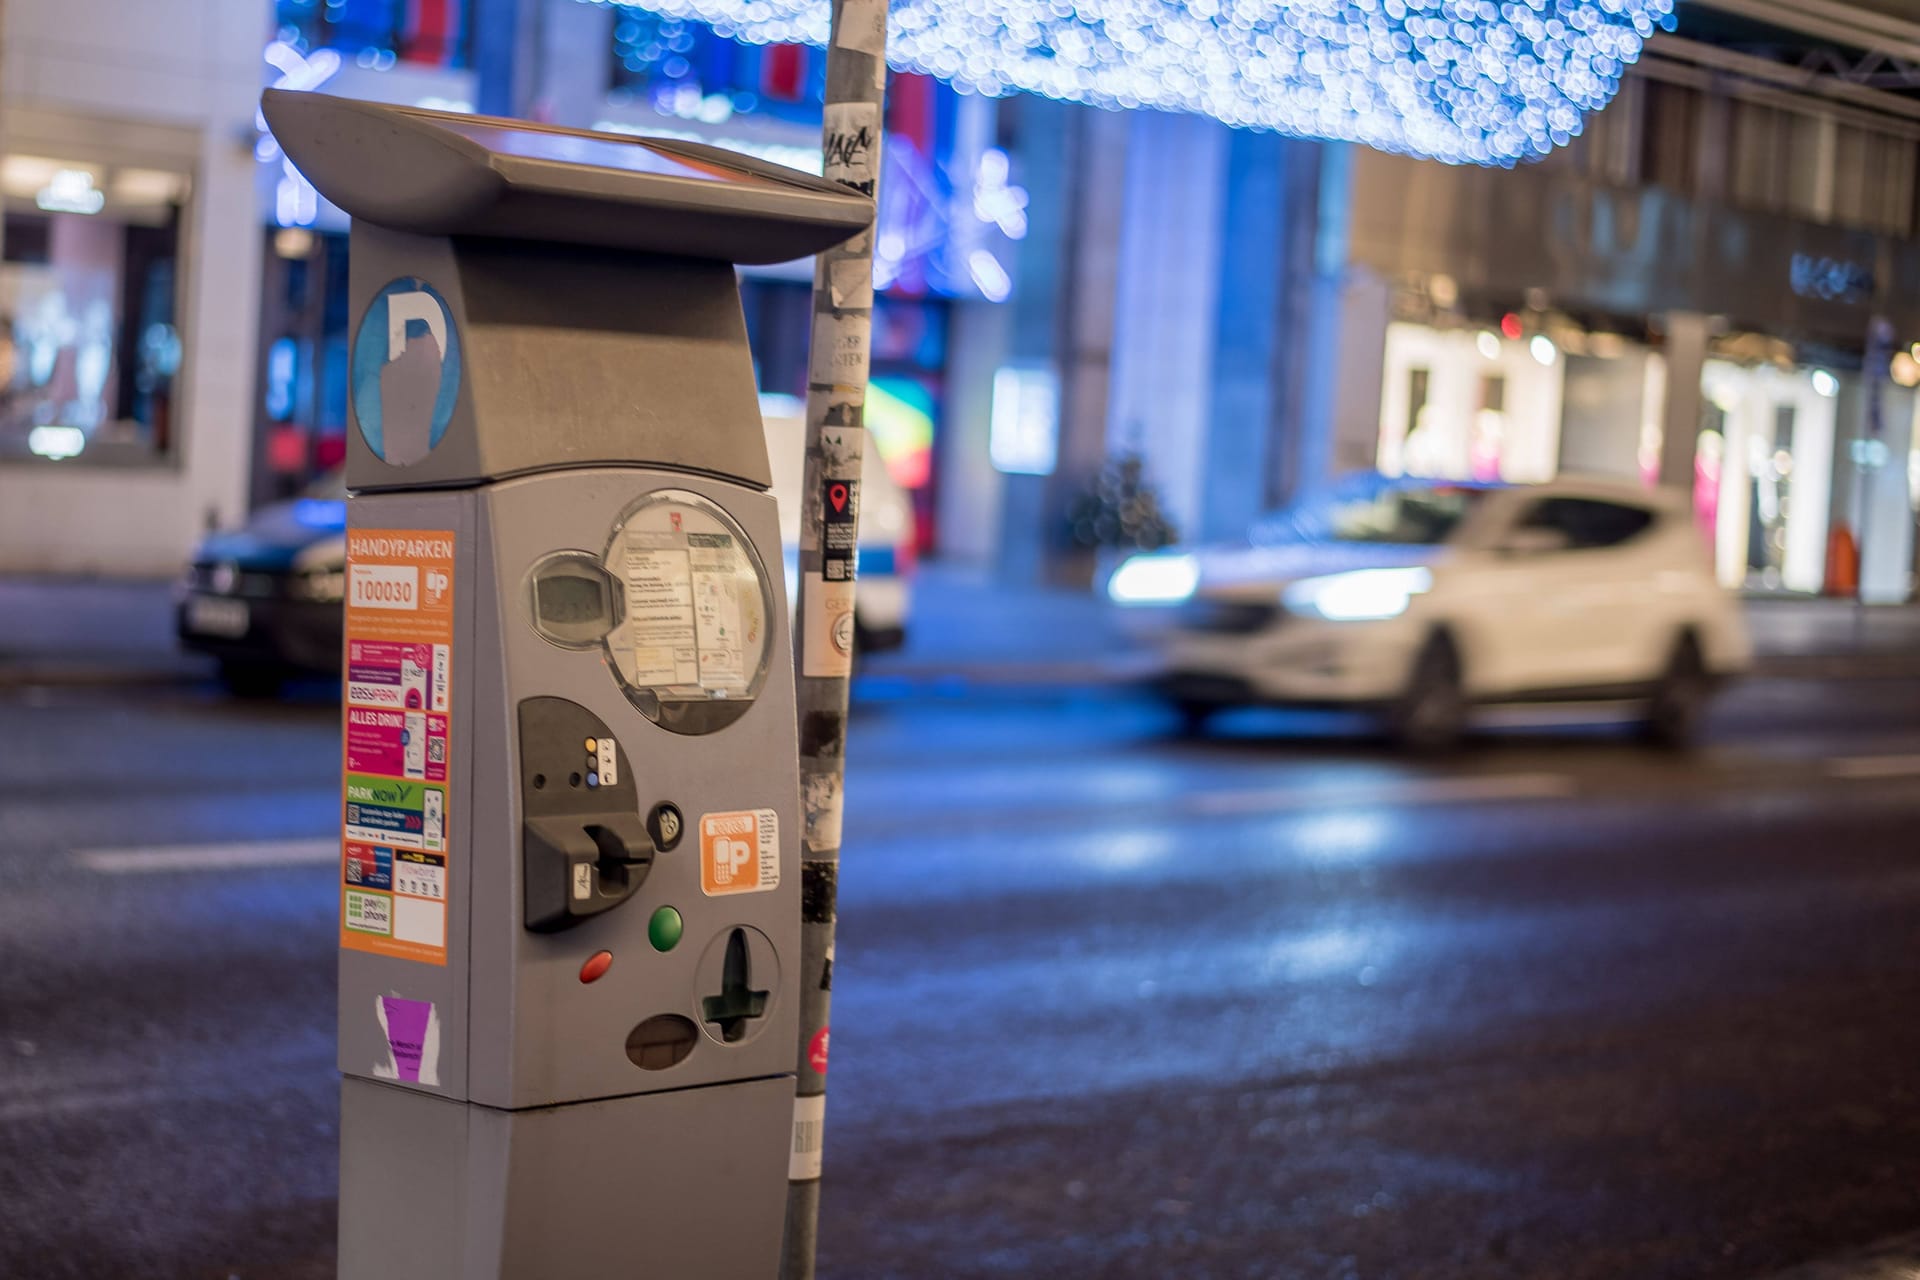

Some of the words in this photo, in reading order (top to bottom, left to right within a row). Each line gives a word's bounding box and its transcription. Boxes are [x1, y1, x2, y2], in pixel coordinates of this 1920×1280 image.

[351, 538, 452, 559] HANDYPARKEN
[357, 580, 412, 603] 100030
[351, 710, 377, 726] ALLES
